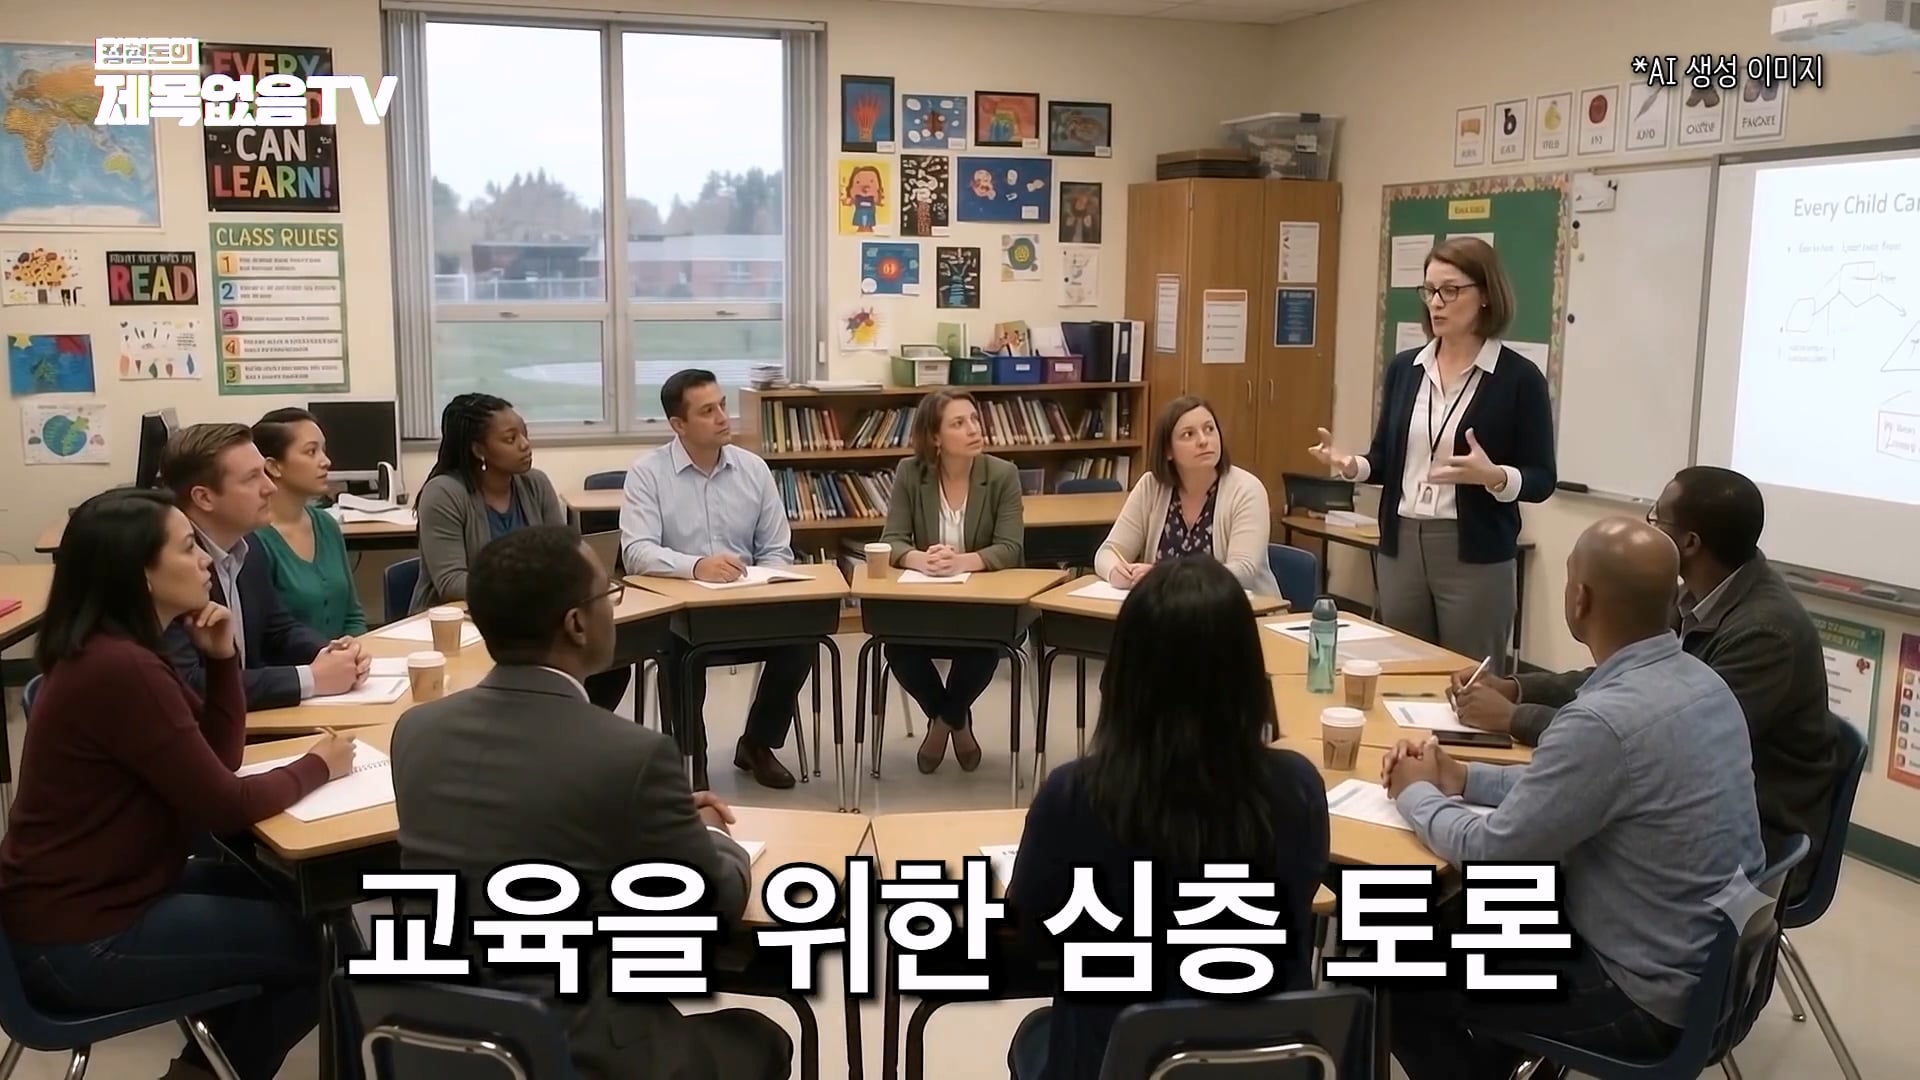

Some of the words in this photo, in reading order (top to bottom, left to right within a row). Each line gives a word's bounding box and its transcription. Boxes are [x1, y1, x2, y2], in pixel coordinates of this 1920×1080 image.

[236, 128, 307, 162] CAN
[213, 165, 331, 198] LEARN!
[1794, 198, 1839, 222] Every
[1844, 192, 1888, 214] Child
[1894, 192, 1920, 213] Ca
[216, 227, 274, 247] CLASS
[281, 228, 338, 247] RULES
[222, 255, 230, 273] 1
[110, 265, 196, 301] READ
[221, 282, 235, 300] 2
